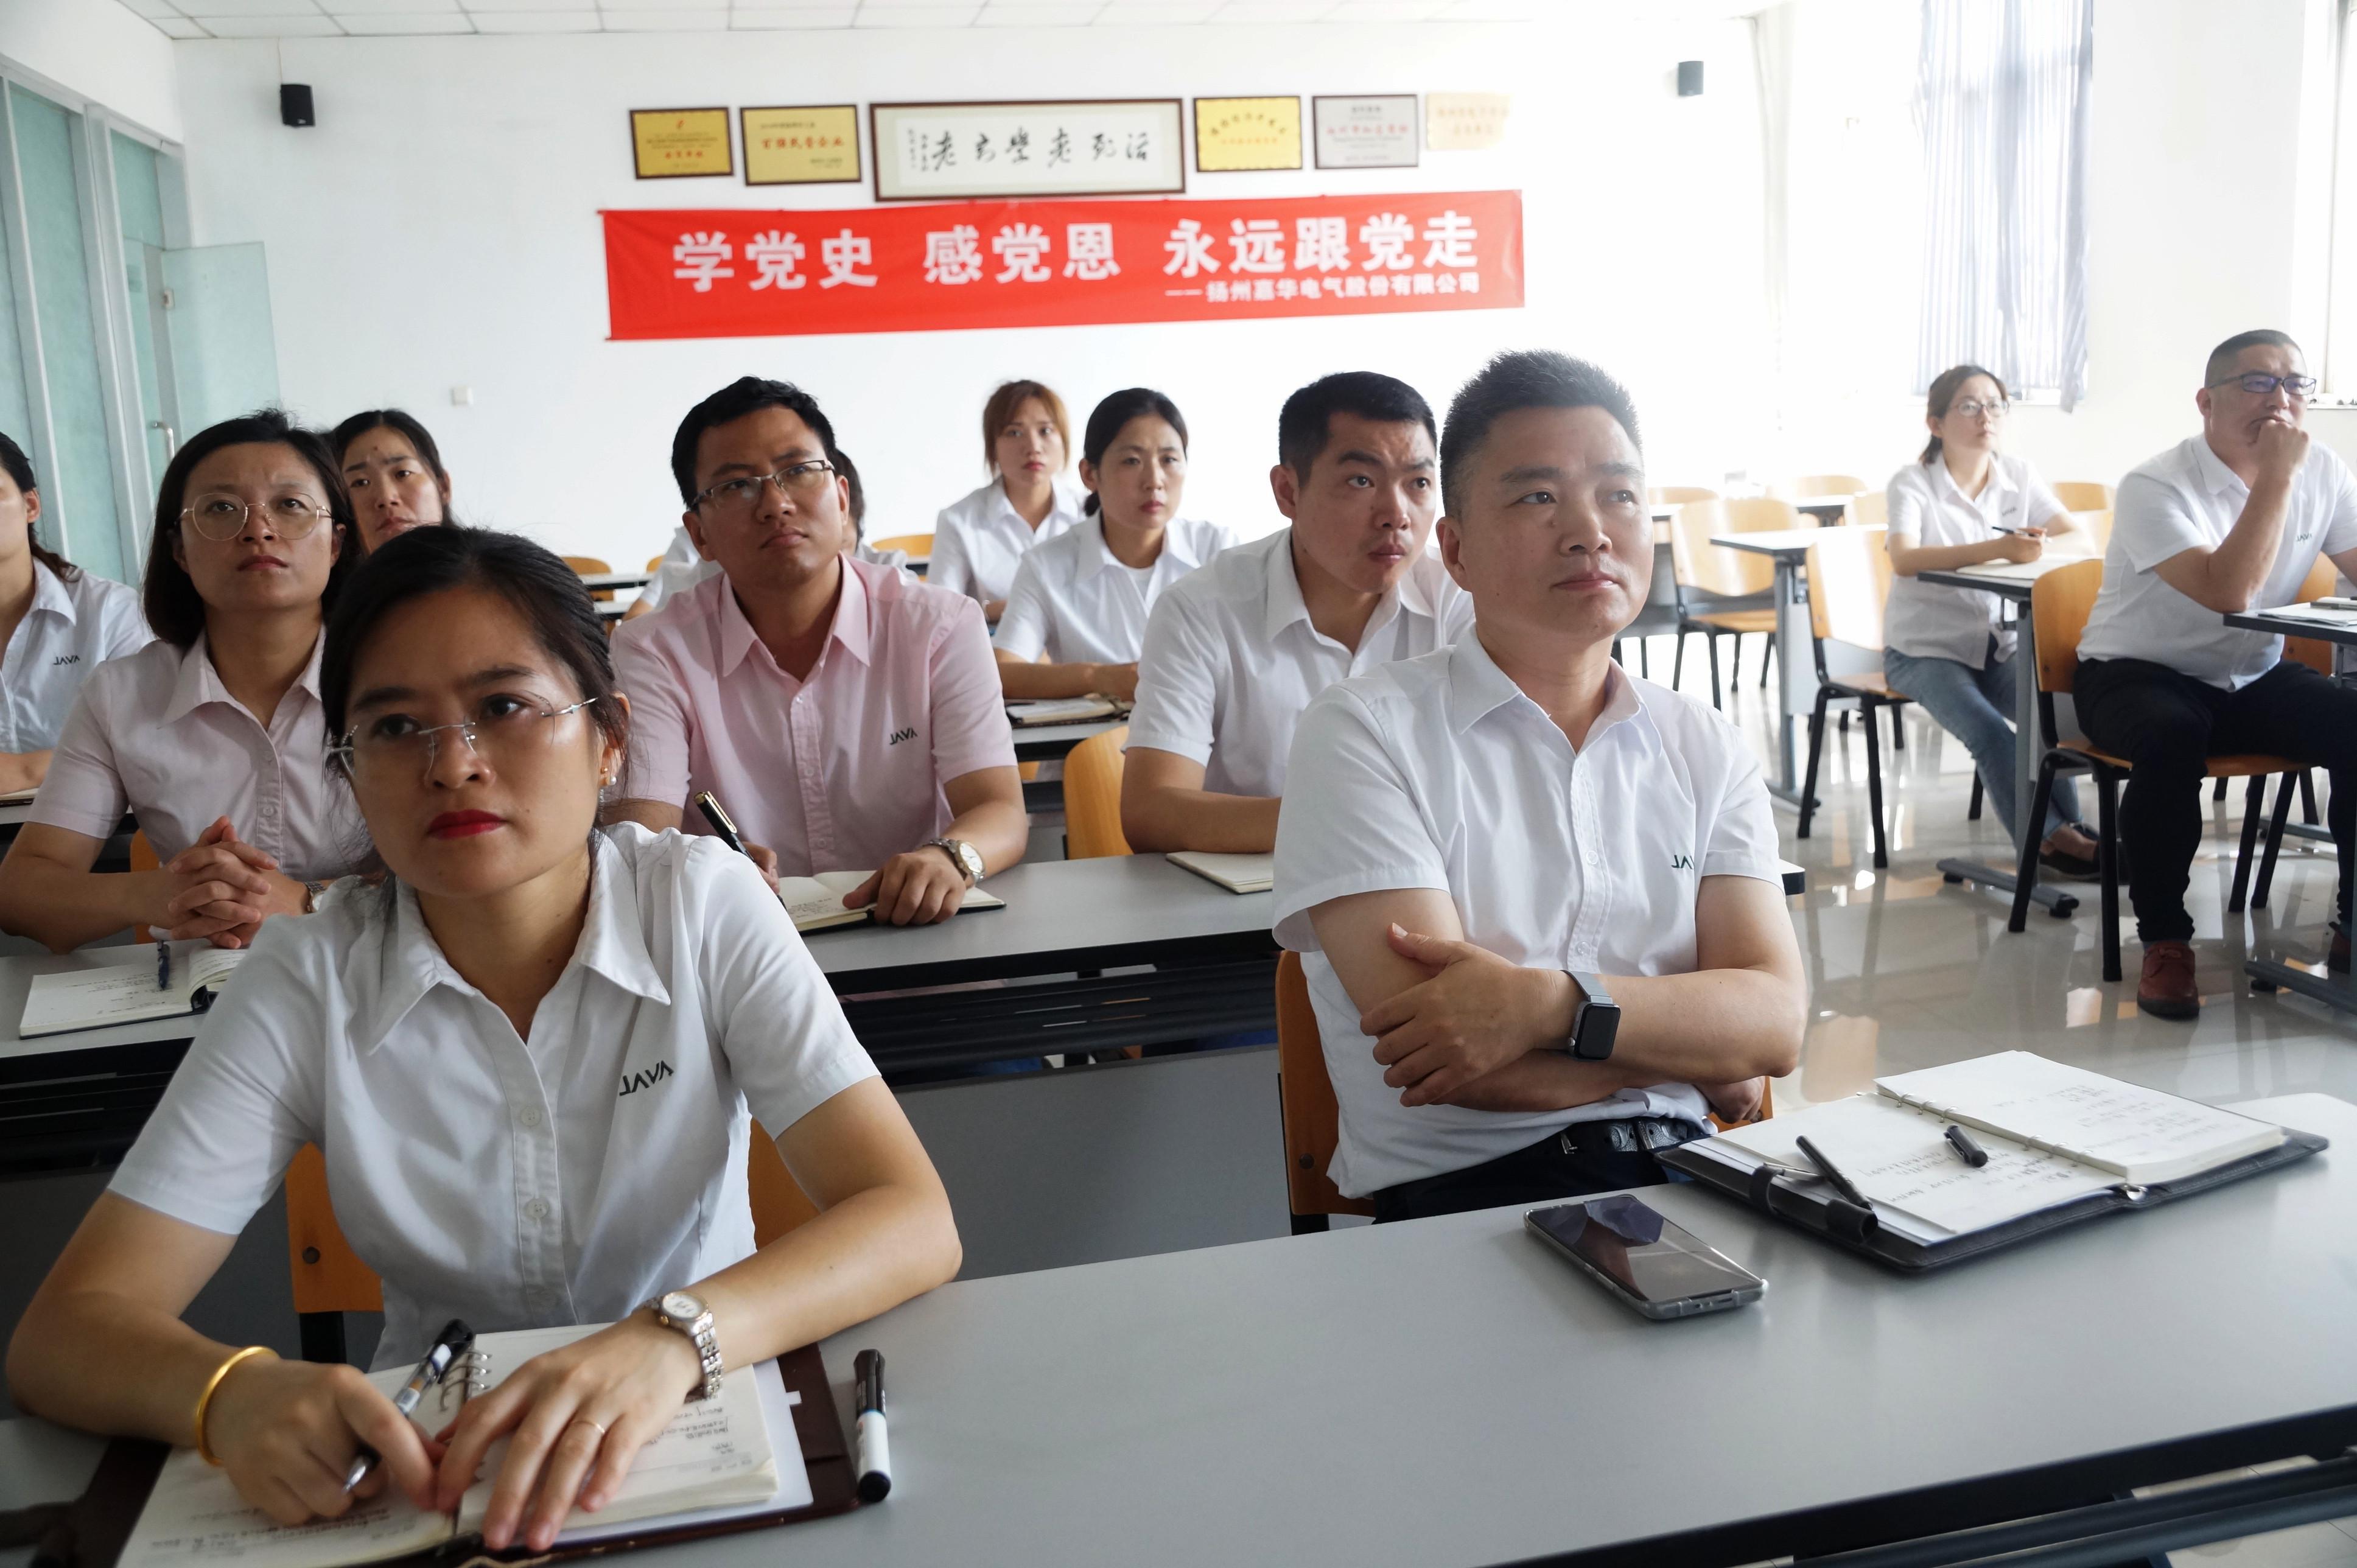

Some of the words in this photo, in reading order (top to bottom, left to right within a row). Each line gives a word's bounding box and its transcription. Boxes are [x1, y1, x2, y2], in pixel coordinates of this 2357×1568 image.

[673, 228, 878, 292] 学党史
[923, 222, 1121, 285] 感党恩
[1163, 211, 1478, 277] 永远跟党走
[53, 654, 81, 665] JAVA
[889, 727, 918, 745] JAVA
[618, 1060, 674, 1096] JAVA
